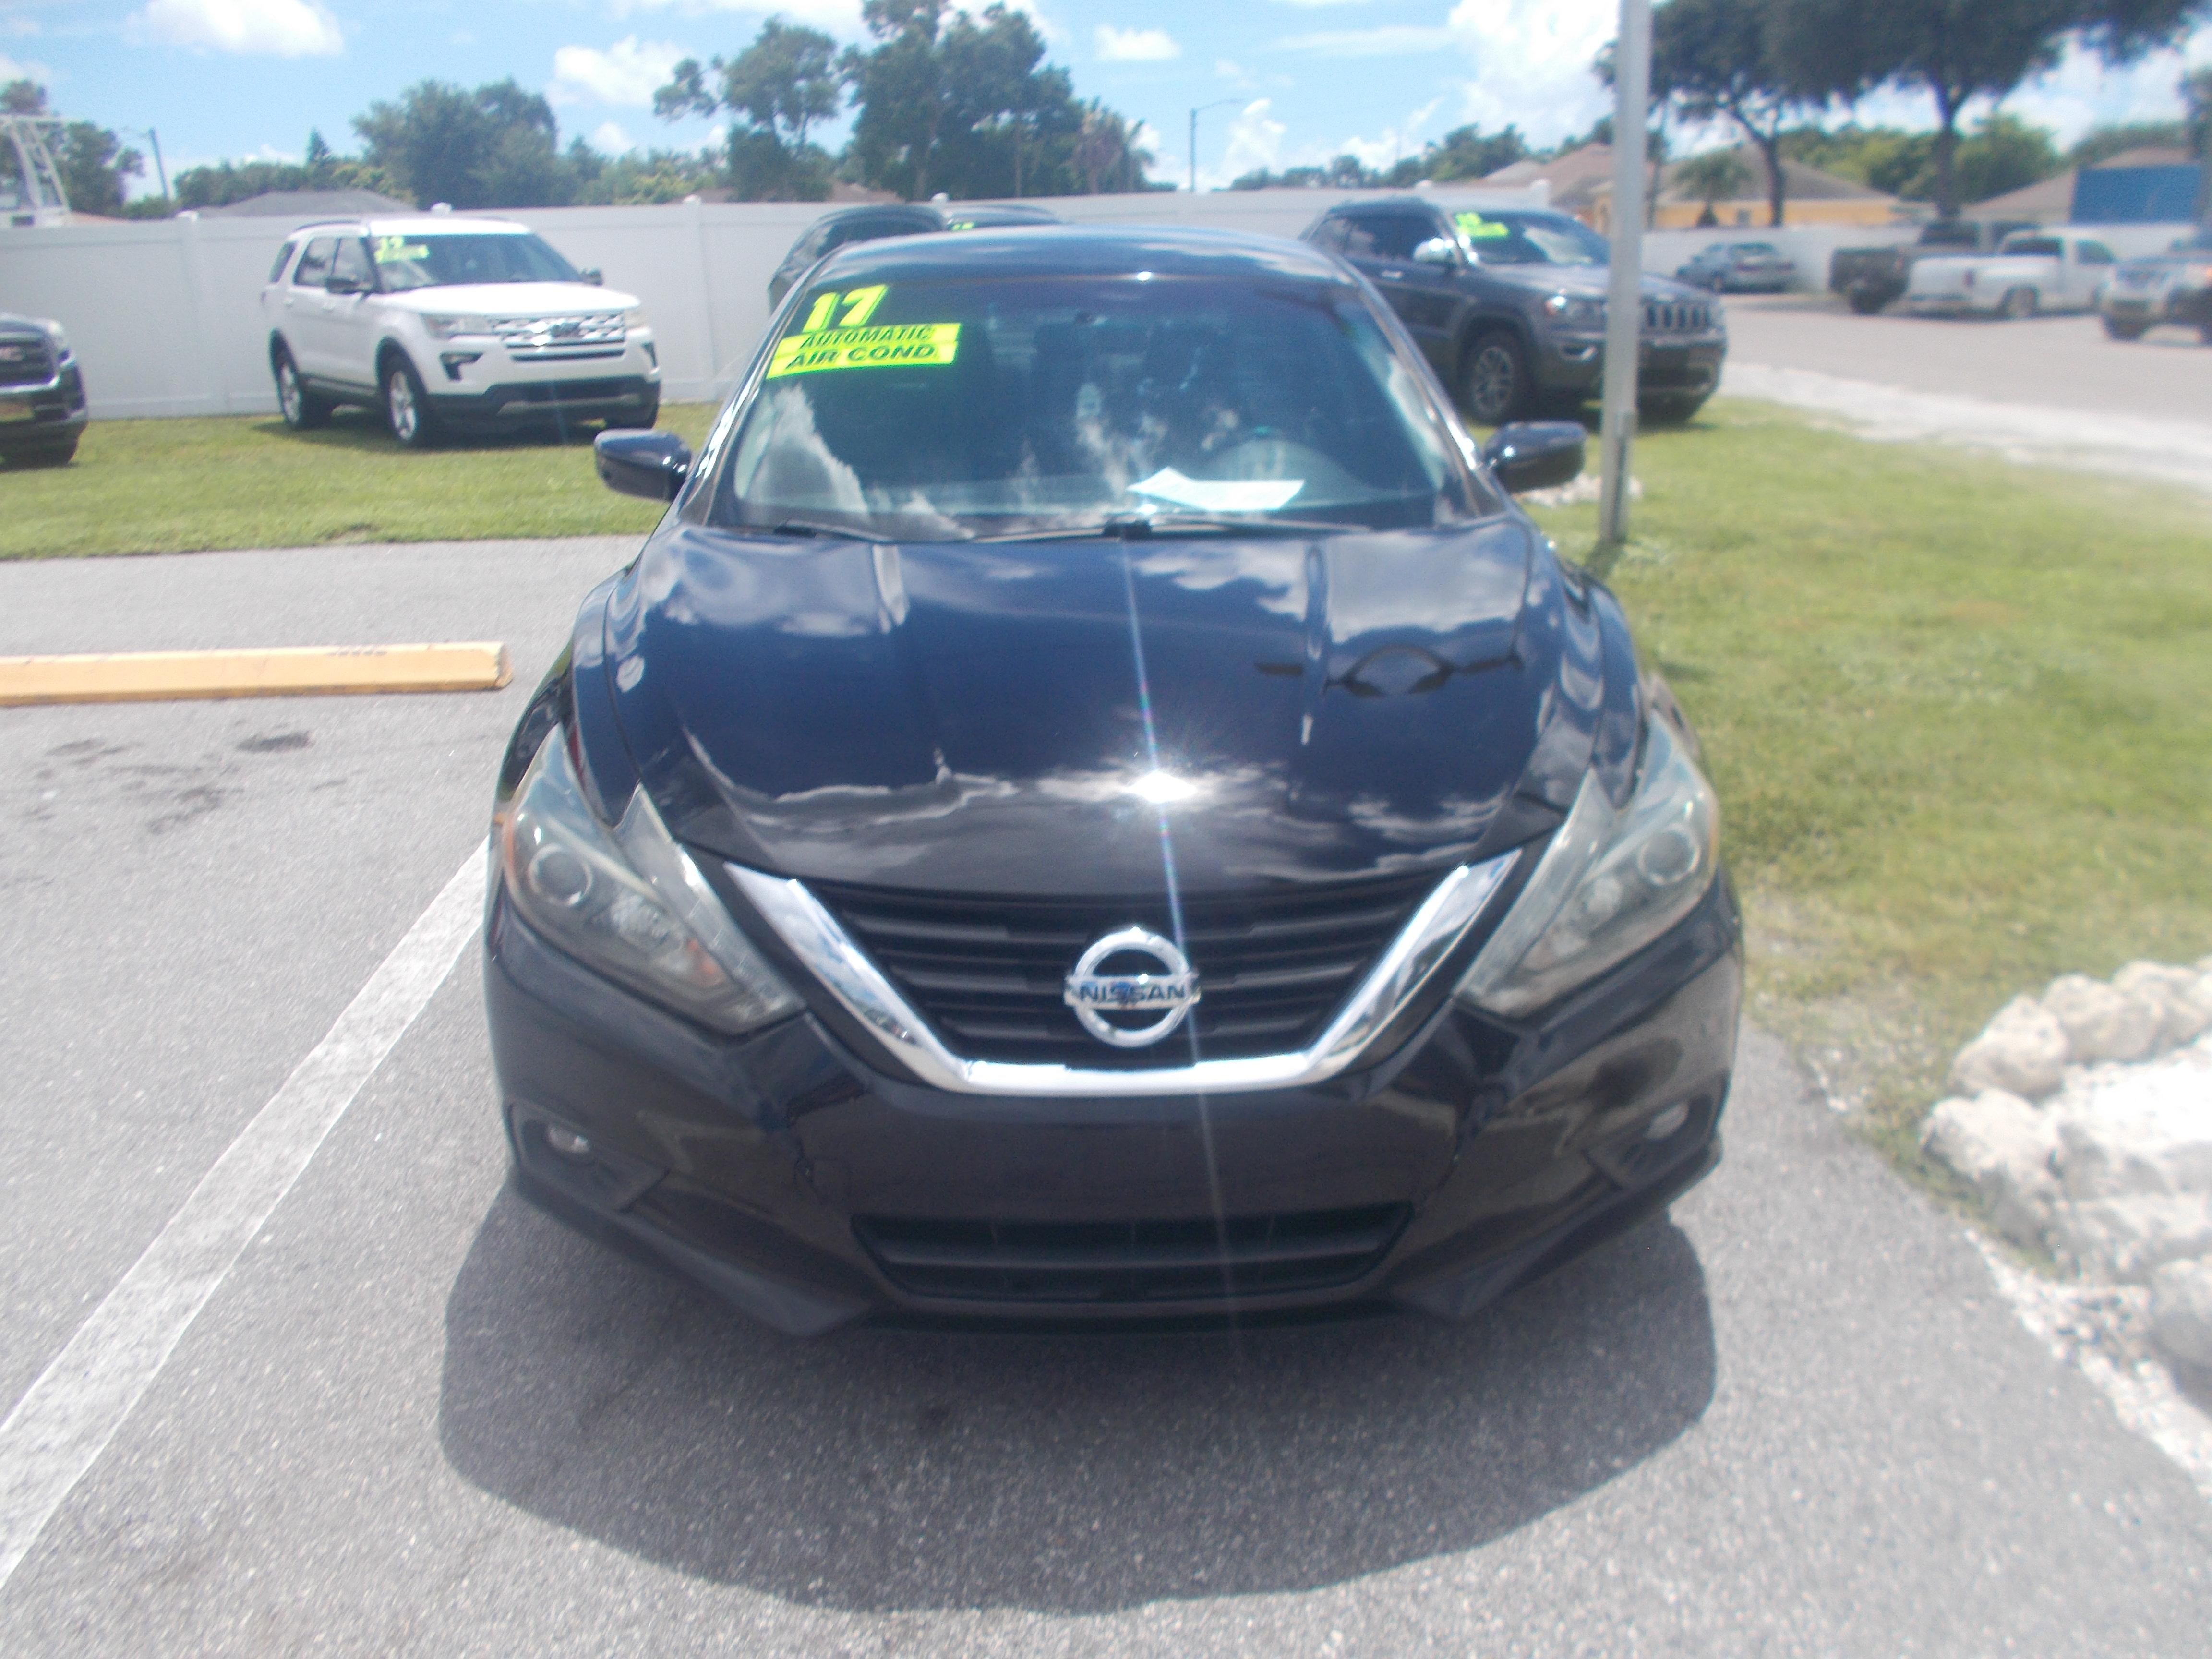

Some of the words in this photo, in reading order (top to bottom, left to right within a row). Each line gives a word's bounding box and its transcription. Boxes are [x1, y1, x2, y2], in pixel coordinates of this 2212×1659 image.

[802, 284, 888, 332] 17
[799, 325, 931, 349] AUTOMATIC
[785, 350, 838, 369] AIR
[1080, 985, 1185, 1002] NISSAN
